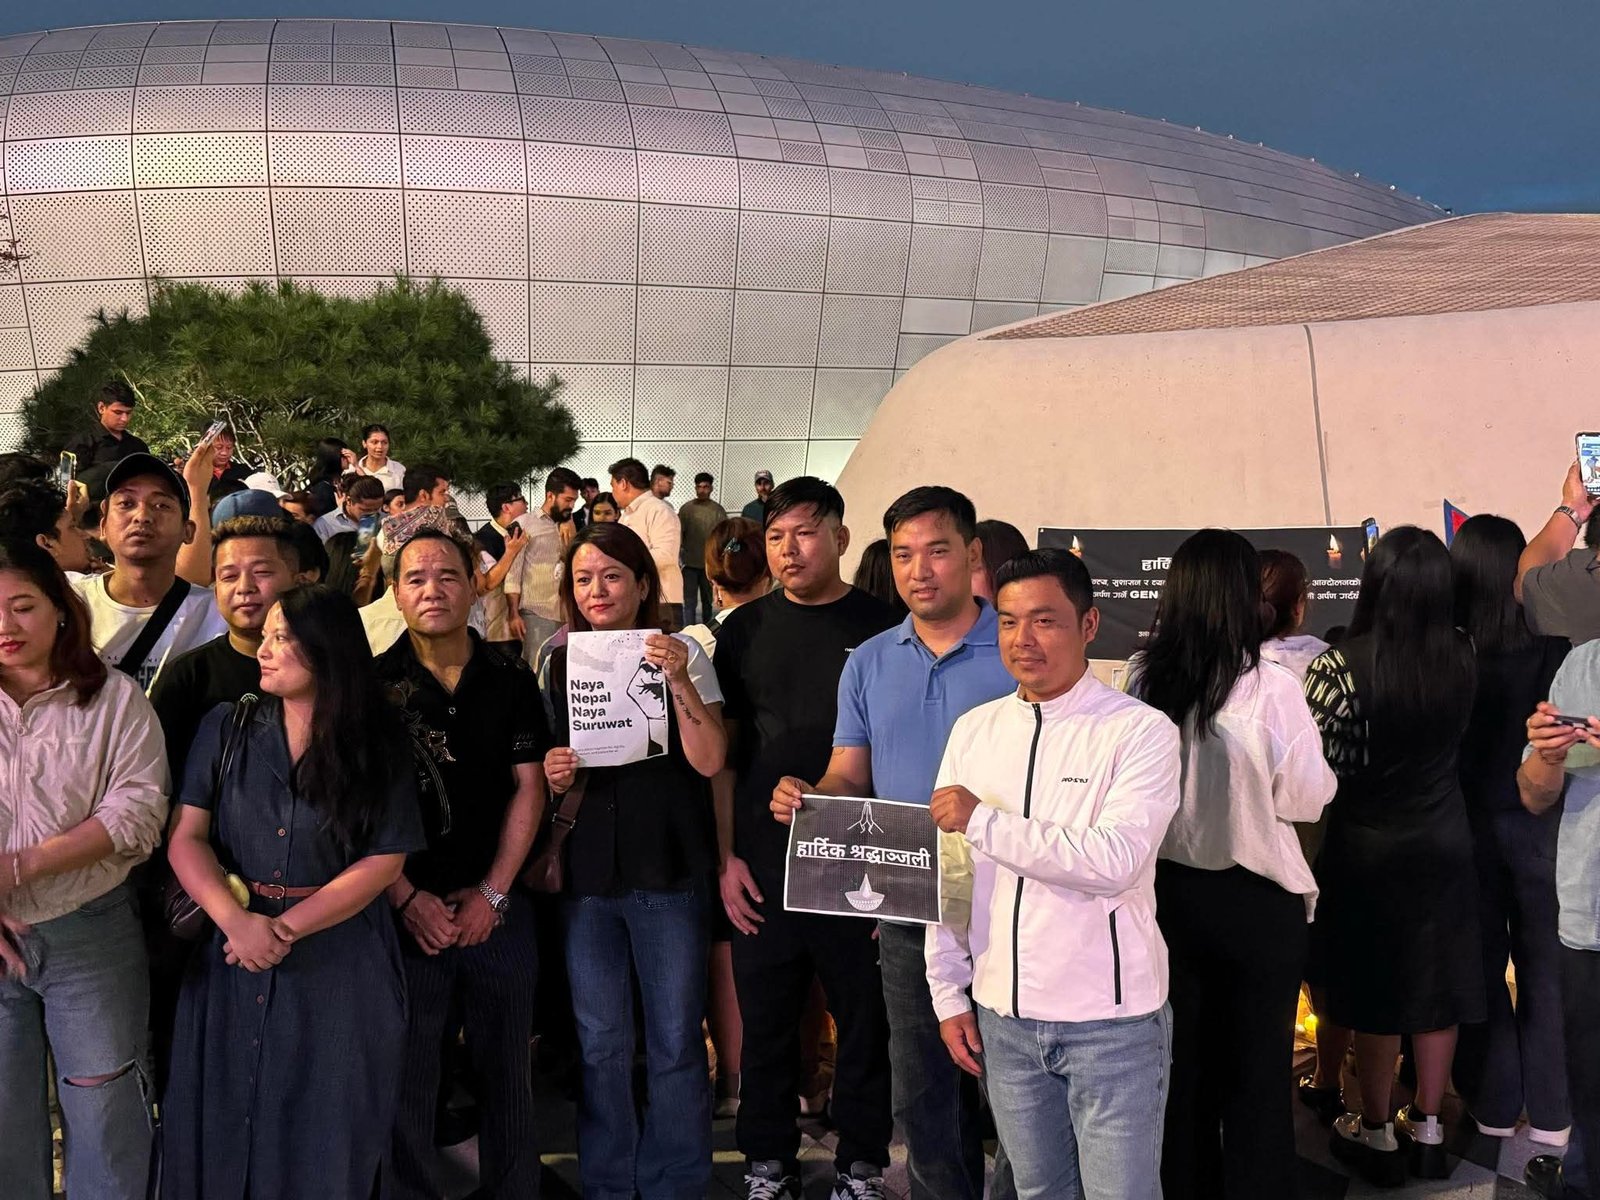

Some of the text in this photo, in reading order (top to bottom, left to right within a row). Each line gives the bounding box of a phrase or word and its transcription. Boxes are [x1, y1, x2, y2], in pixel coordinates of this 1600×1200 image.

[1129, 590, 1159, 599] GEN
[570, 679, 605, 692] Naya
[571, 692, 612, 706] Nepal
[572, 707, 606, 719] Naya
[573, 717, 633, 731] Suruwat
[796, 837, 932, 868] हार्दिक श्रद्धाञ्जली
